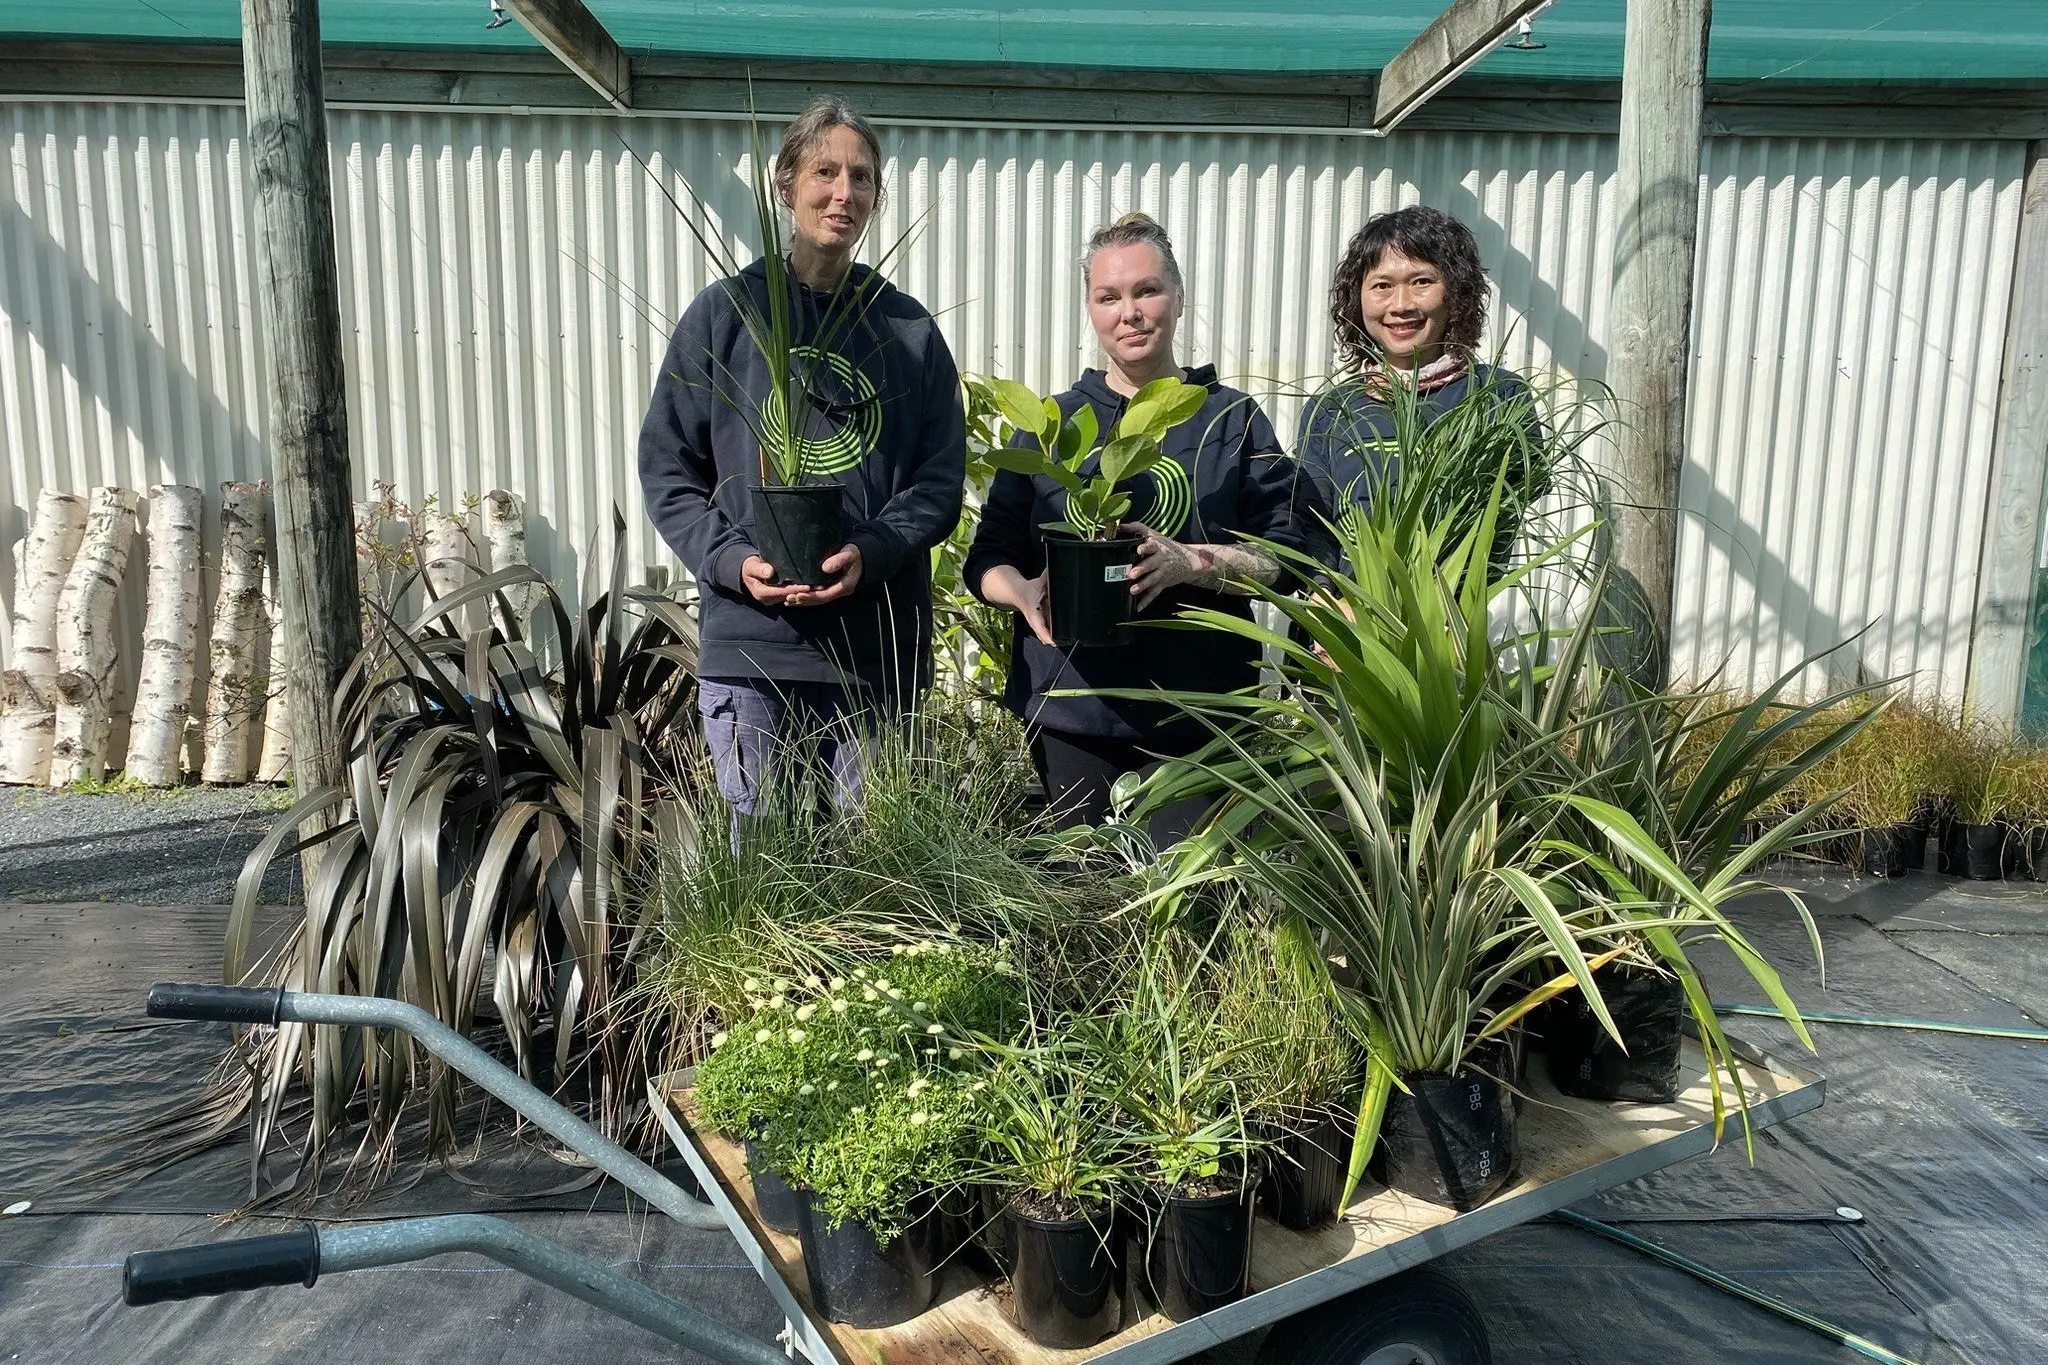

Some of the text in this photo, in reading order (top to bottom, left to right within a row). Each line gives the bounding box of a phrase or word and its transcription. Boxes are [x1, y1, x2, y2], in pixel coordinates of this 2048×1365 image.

[1578, 997, 1590, 1019] B5
[1580, 1057, 1592, 1080] PB5
[1469, 1083, 1482, 1111] PB5
[1479, 1149, 1491, 1178] PB5
